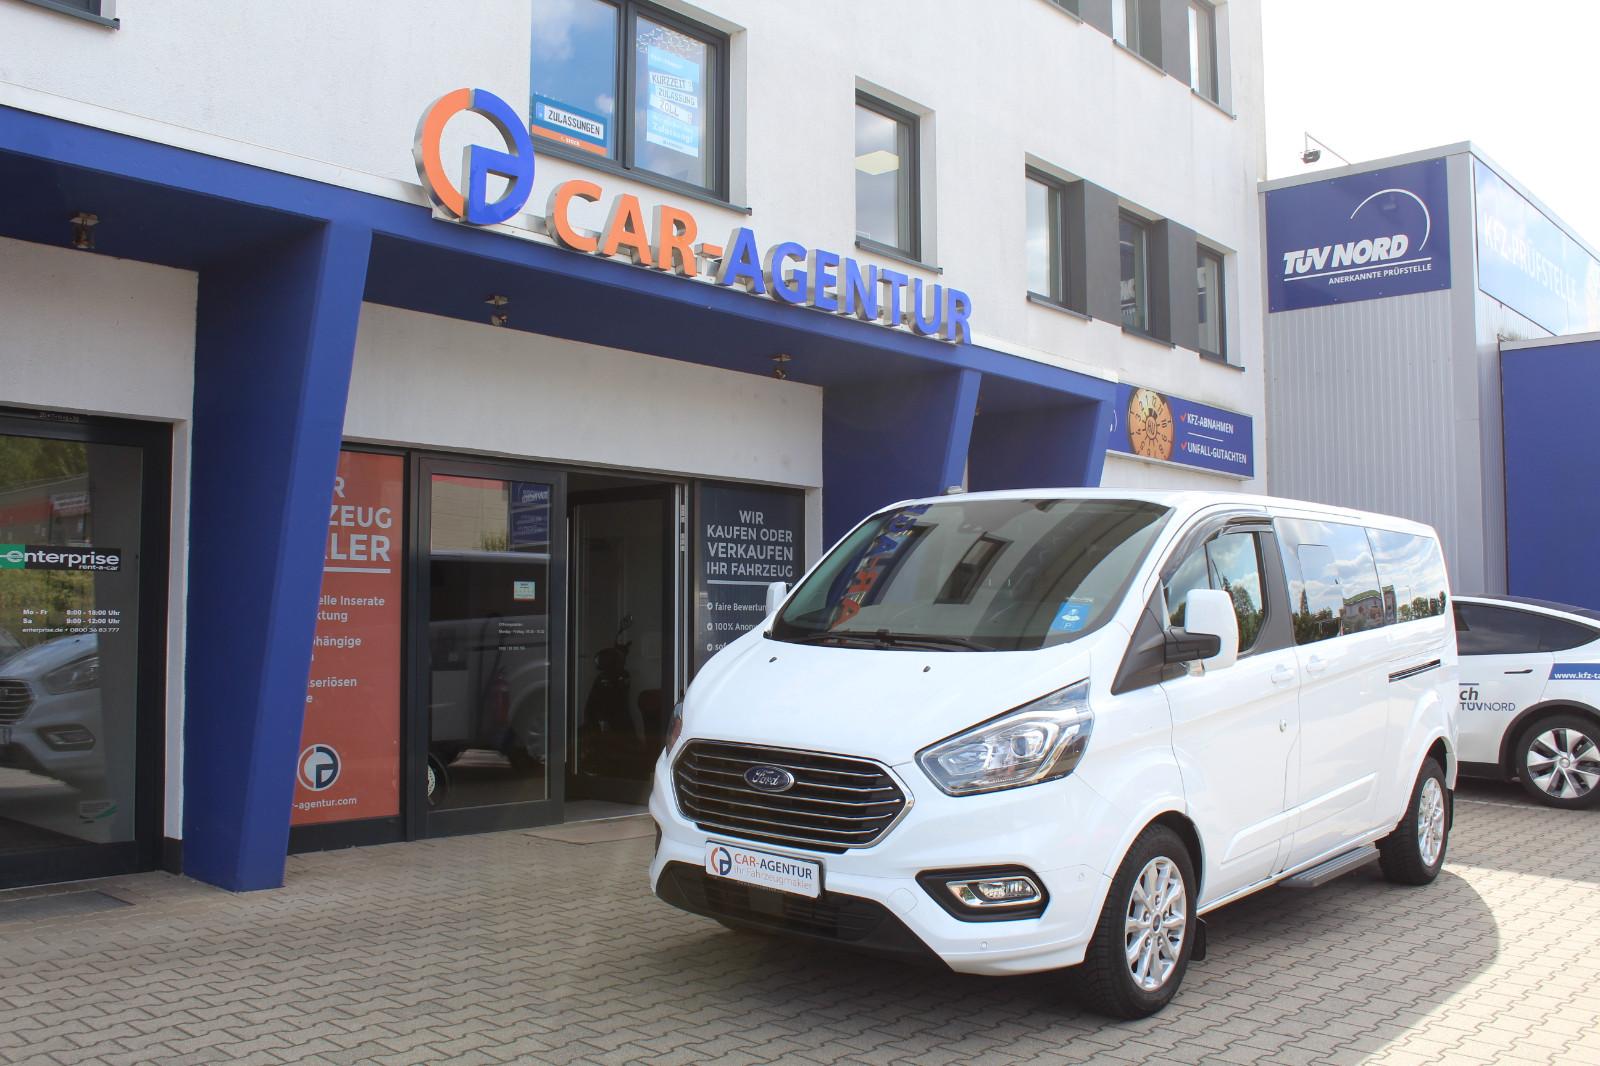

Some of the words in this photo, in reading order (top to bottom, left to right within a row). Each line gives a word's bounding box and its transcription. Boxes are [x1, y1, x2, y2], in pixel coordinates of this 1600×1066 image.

[547, 109, 601, 136] ZULASSUNGEN
[1332, 234, 1409, 268] NORD
[546, 179, 971, 344] CAR-AGENTUR
[1328, 270, 1383, 285] ANERKANNTE
[1383, 263, 1432, 277] PRÜFSTELLE
[1186, 412, 1234, 434] KFZ-ABNAHMEN
[1187, 442, 1247, 465] UNFALL-GUTACHTEN
[738, 510, 764, 525] WIR
[706, 524, 757, 540] KAUFEN
[760, 528, 793, 543] ODER
[324, 532, 391, 562] LER
[707, 541, 793, 561] VERKAUFEN
[6, 550, 120, 568] enterprise
[706, 561, 728, 575] IHR
[731, 562, 793, 578] FAHRZEUG
[340, 595, 385, 606] Inserate
[715, 602, 732, 611] faire
[714, 622, 733, 631] 100%
[313, 635, 362, 648] hängige
[308, 676, 357, 688] seriösen
[1459, 686, 1479, 701] ch
[1459, 701, 1516, 711] TÜVNORD
[751, 769, 780, 786] Ford
[292, 797, 357, 811] -agentur.com
[734, 853, 812, 879] CAR-AGENTUR
